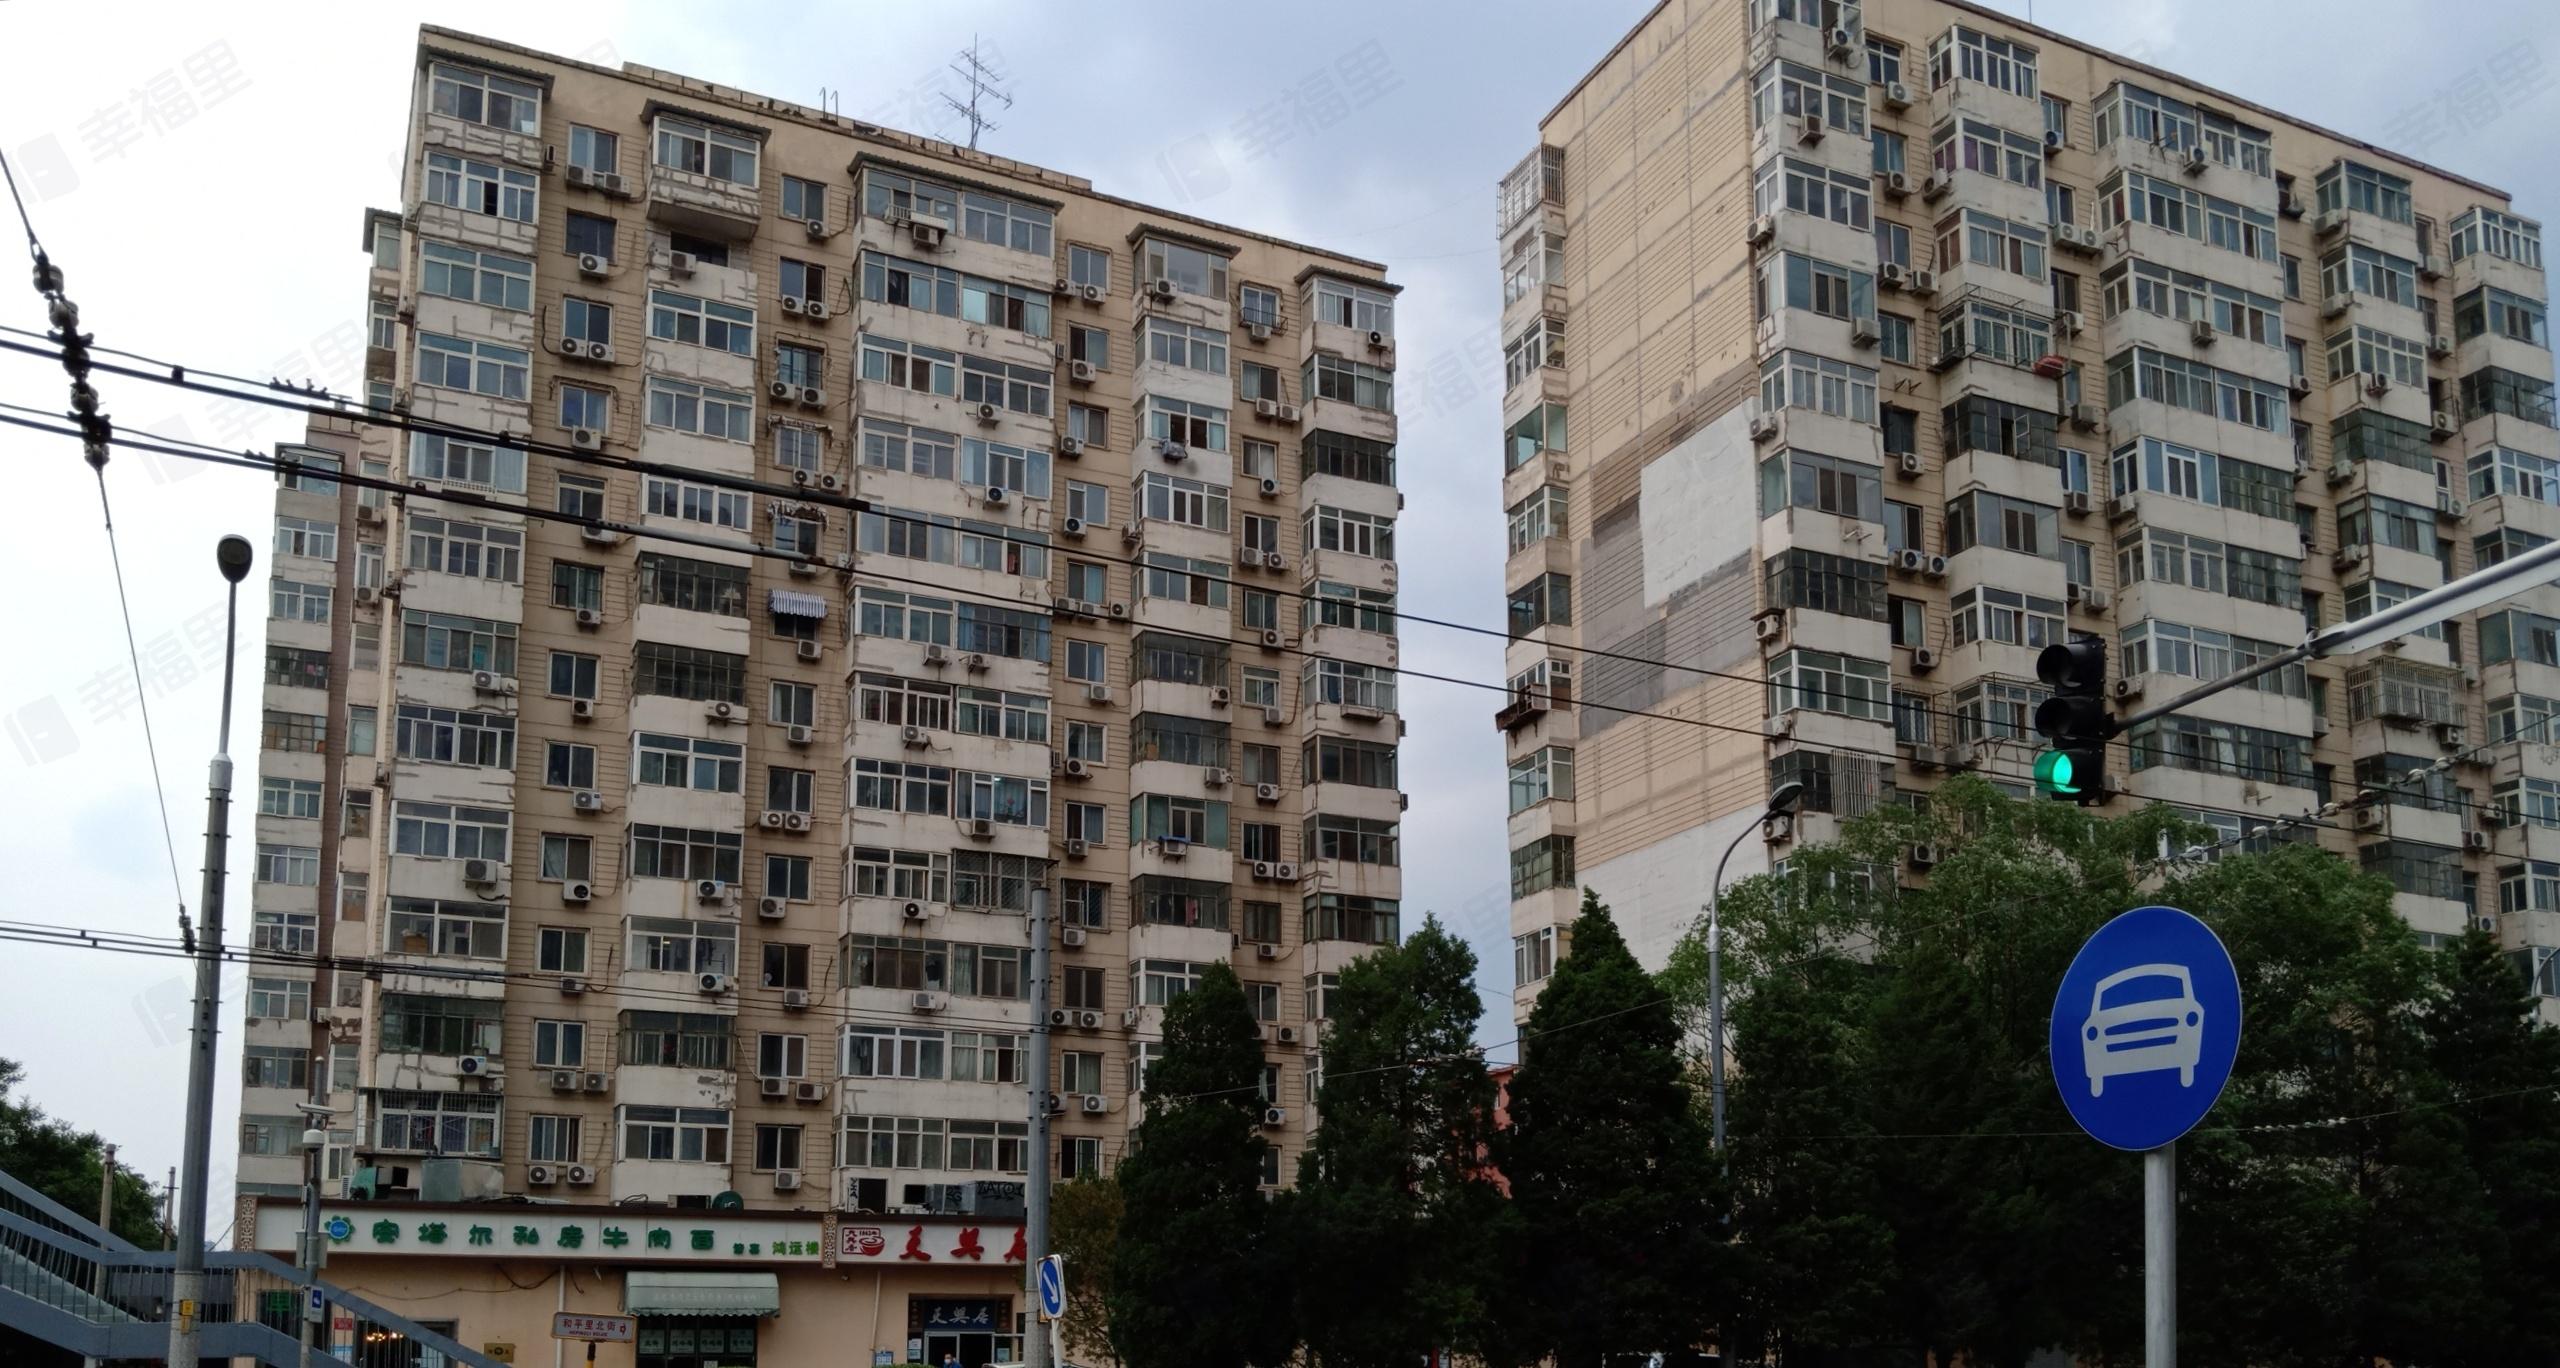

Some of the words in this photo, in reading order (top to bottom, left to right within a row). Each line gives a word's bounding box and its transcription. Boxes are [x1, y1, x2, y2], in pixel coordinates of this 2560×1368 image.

[562, 1318, 617, 1331] 和平里北街
